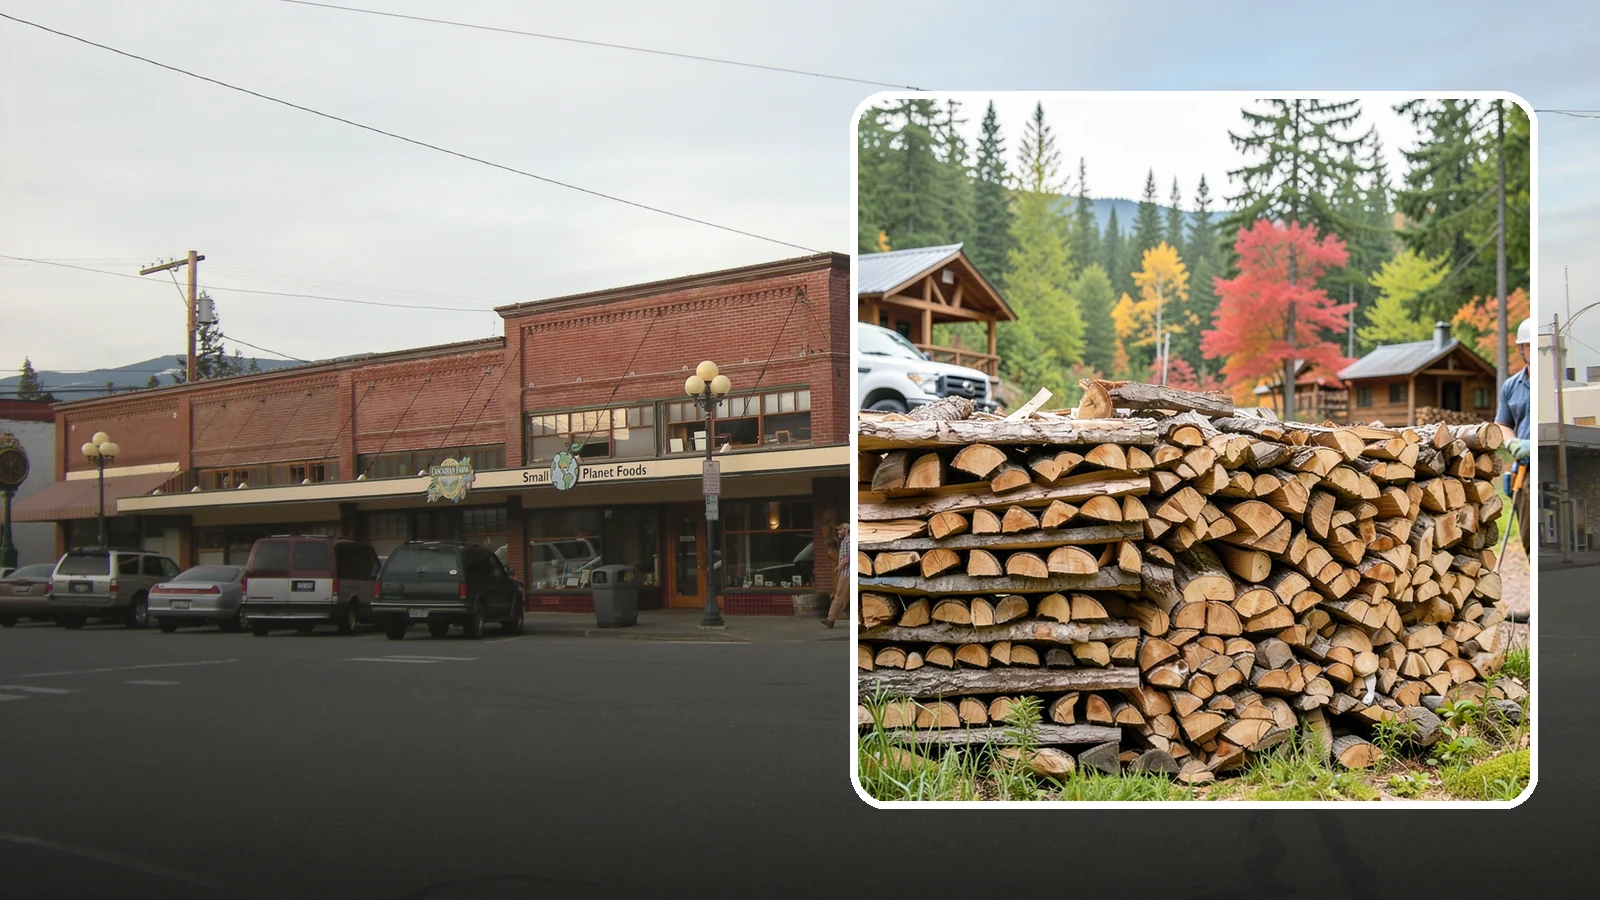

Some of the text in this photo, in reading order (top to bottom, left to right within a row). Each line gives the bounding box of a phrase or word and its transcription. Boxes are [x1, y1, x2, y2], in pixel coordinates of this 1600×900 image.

[455, 465, 469, 474] FARM
[523, 465, 647, 483] Small Planet Foods
